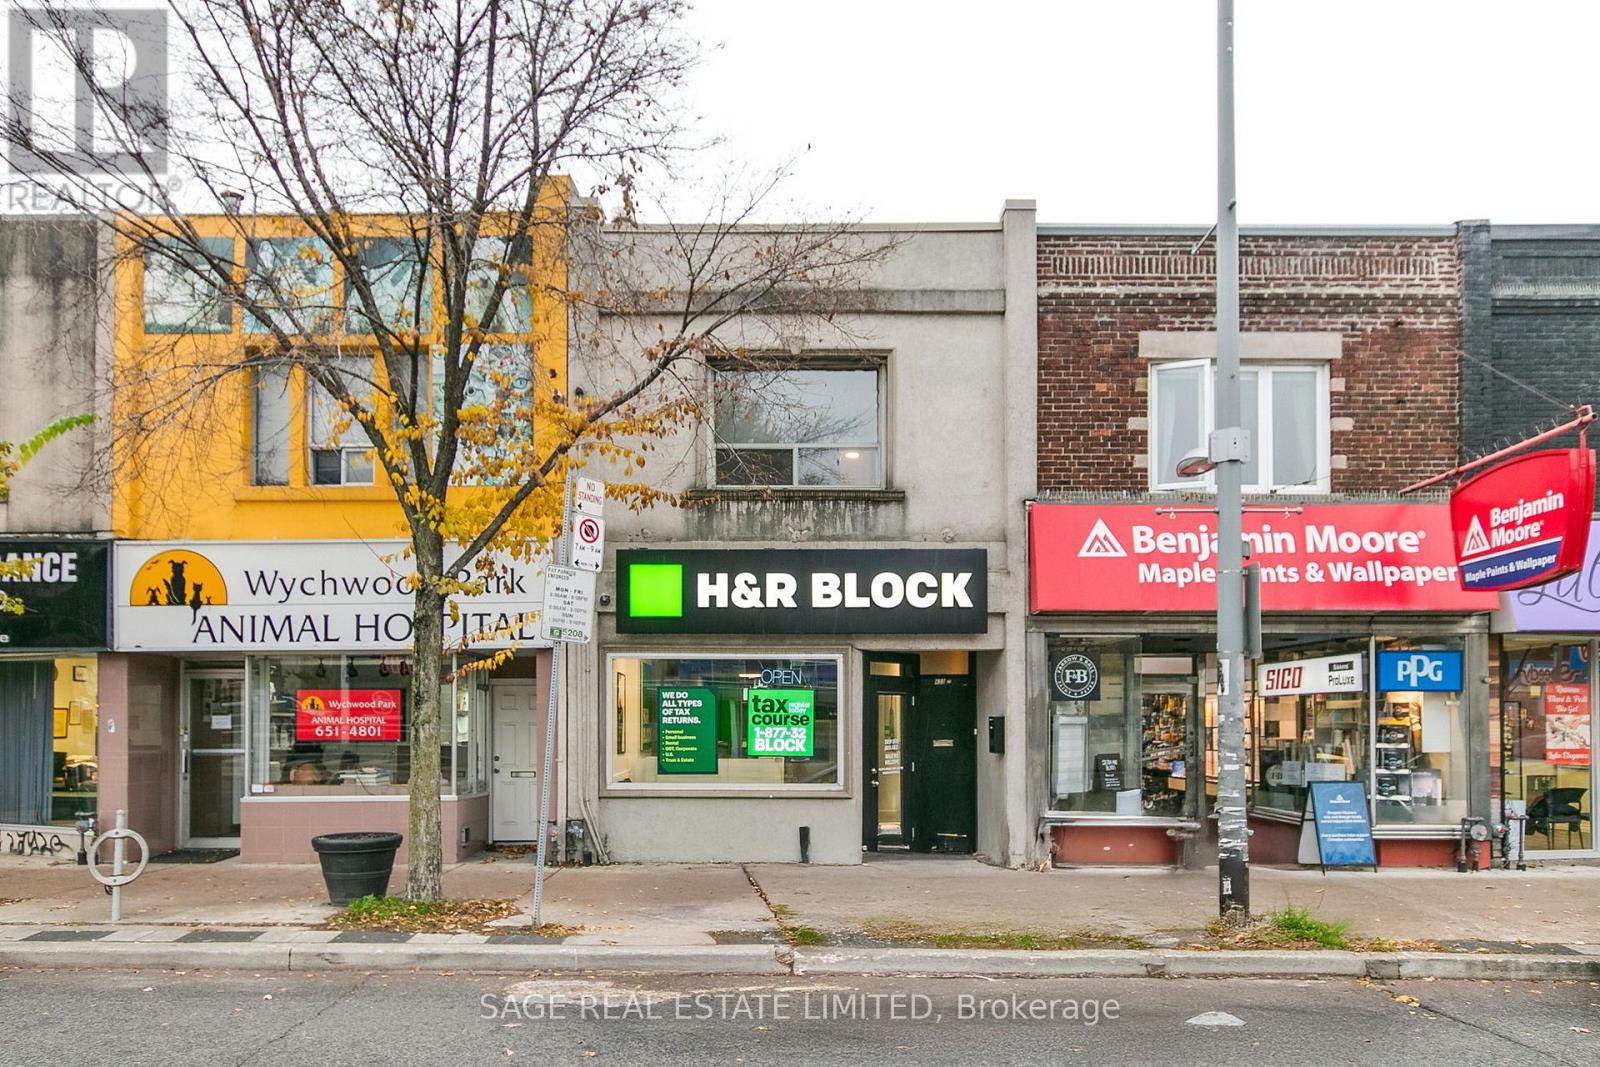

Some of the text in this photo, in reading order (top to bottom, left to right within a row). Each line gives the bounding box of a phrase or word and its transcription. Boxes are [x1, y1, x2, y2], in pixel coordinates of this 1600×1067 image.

[587, 482, 595, 492] NO
[578, 491, 603, 505] STANDING
[1490, 489, 1564, 527] Benjamin
[1139, 562, 1216, 587] Maple
[1305, 562, 1325, 583] &
[1327, 560, 1459, 587] Wallpaper
[1465, 554, 1557, 582] Maple Paints & Wallpaper
[244, 569, 418, 604] Wychwoo
[697, 572, 974, 608] H&R BLOCK
[192, 613, 535, 643] ANIMAL HOPITAL
[562, 628, 583, 638] 5208
[761, 669, 802, 685] OPEN
[1265, 665, 1304, 691] SICO
[1396, 655, 1443, 687] PPG
[328, 700, 397, 710] Wychwood Park
[751, 695, 788, 713] tax
[312, 716, 386, 725] ANIMAL HOSPITAL
[752, 713, 810, 726] course
[754, 727, 806, 738] 1-877-32
[754, 738, 806, 752] BLOCK
